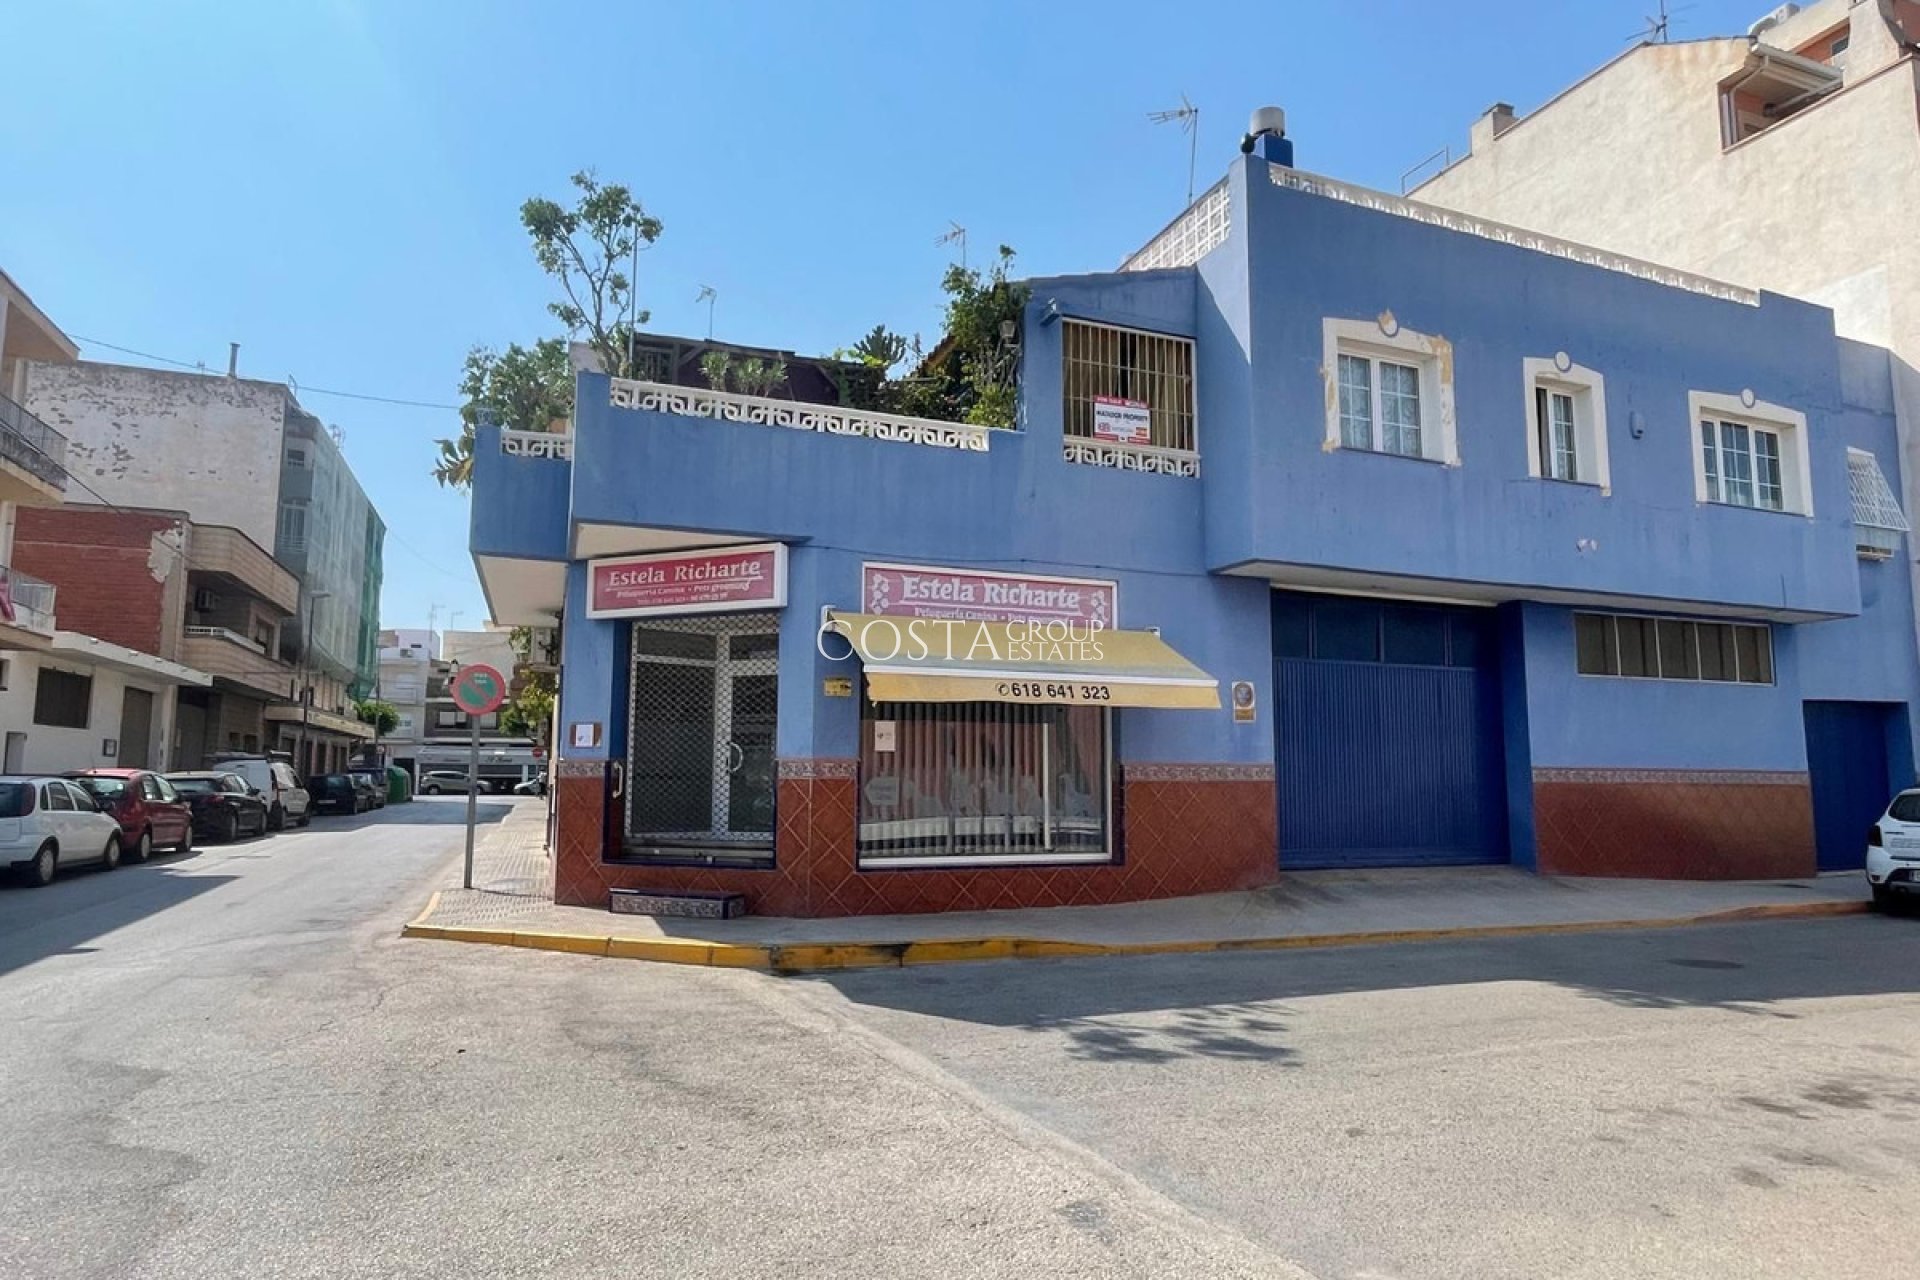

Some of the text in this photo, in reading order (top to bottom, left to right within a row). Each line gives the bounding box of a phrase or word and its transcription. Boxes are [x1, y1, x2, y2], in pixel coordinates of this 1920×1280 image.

[609, 560, 761, 587] Estela Richarte
[902, 576, 1080, 609] Estela Richarte
[1011, 682, 1111, 701] 618 641 323
